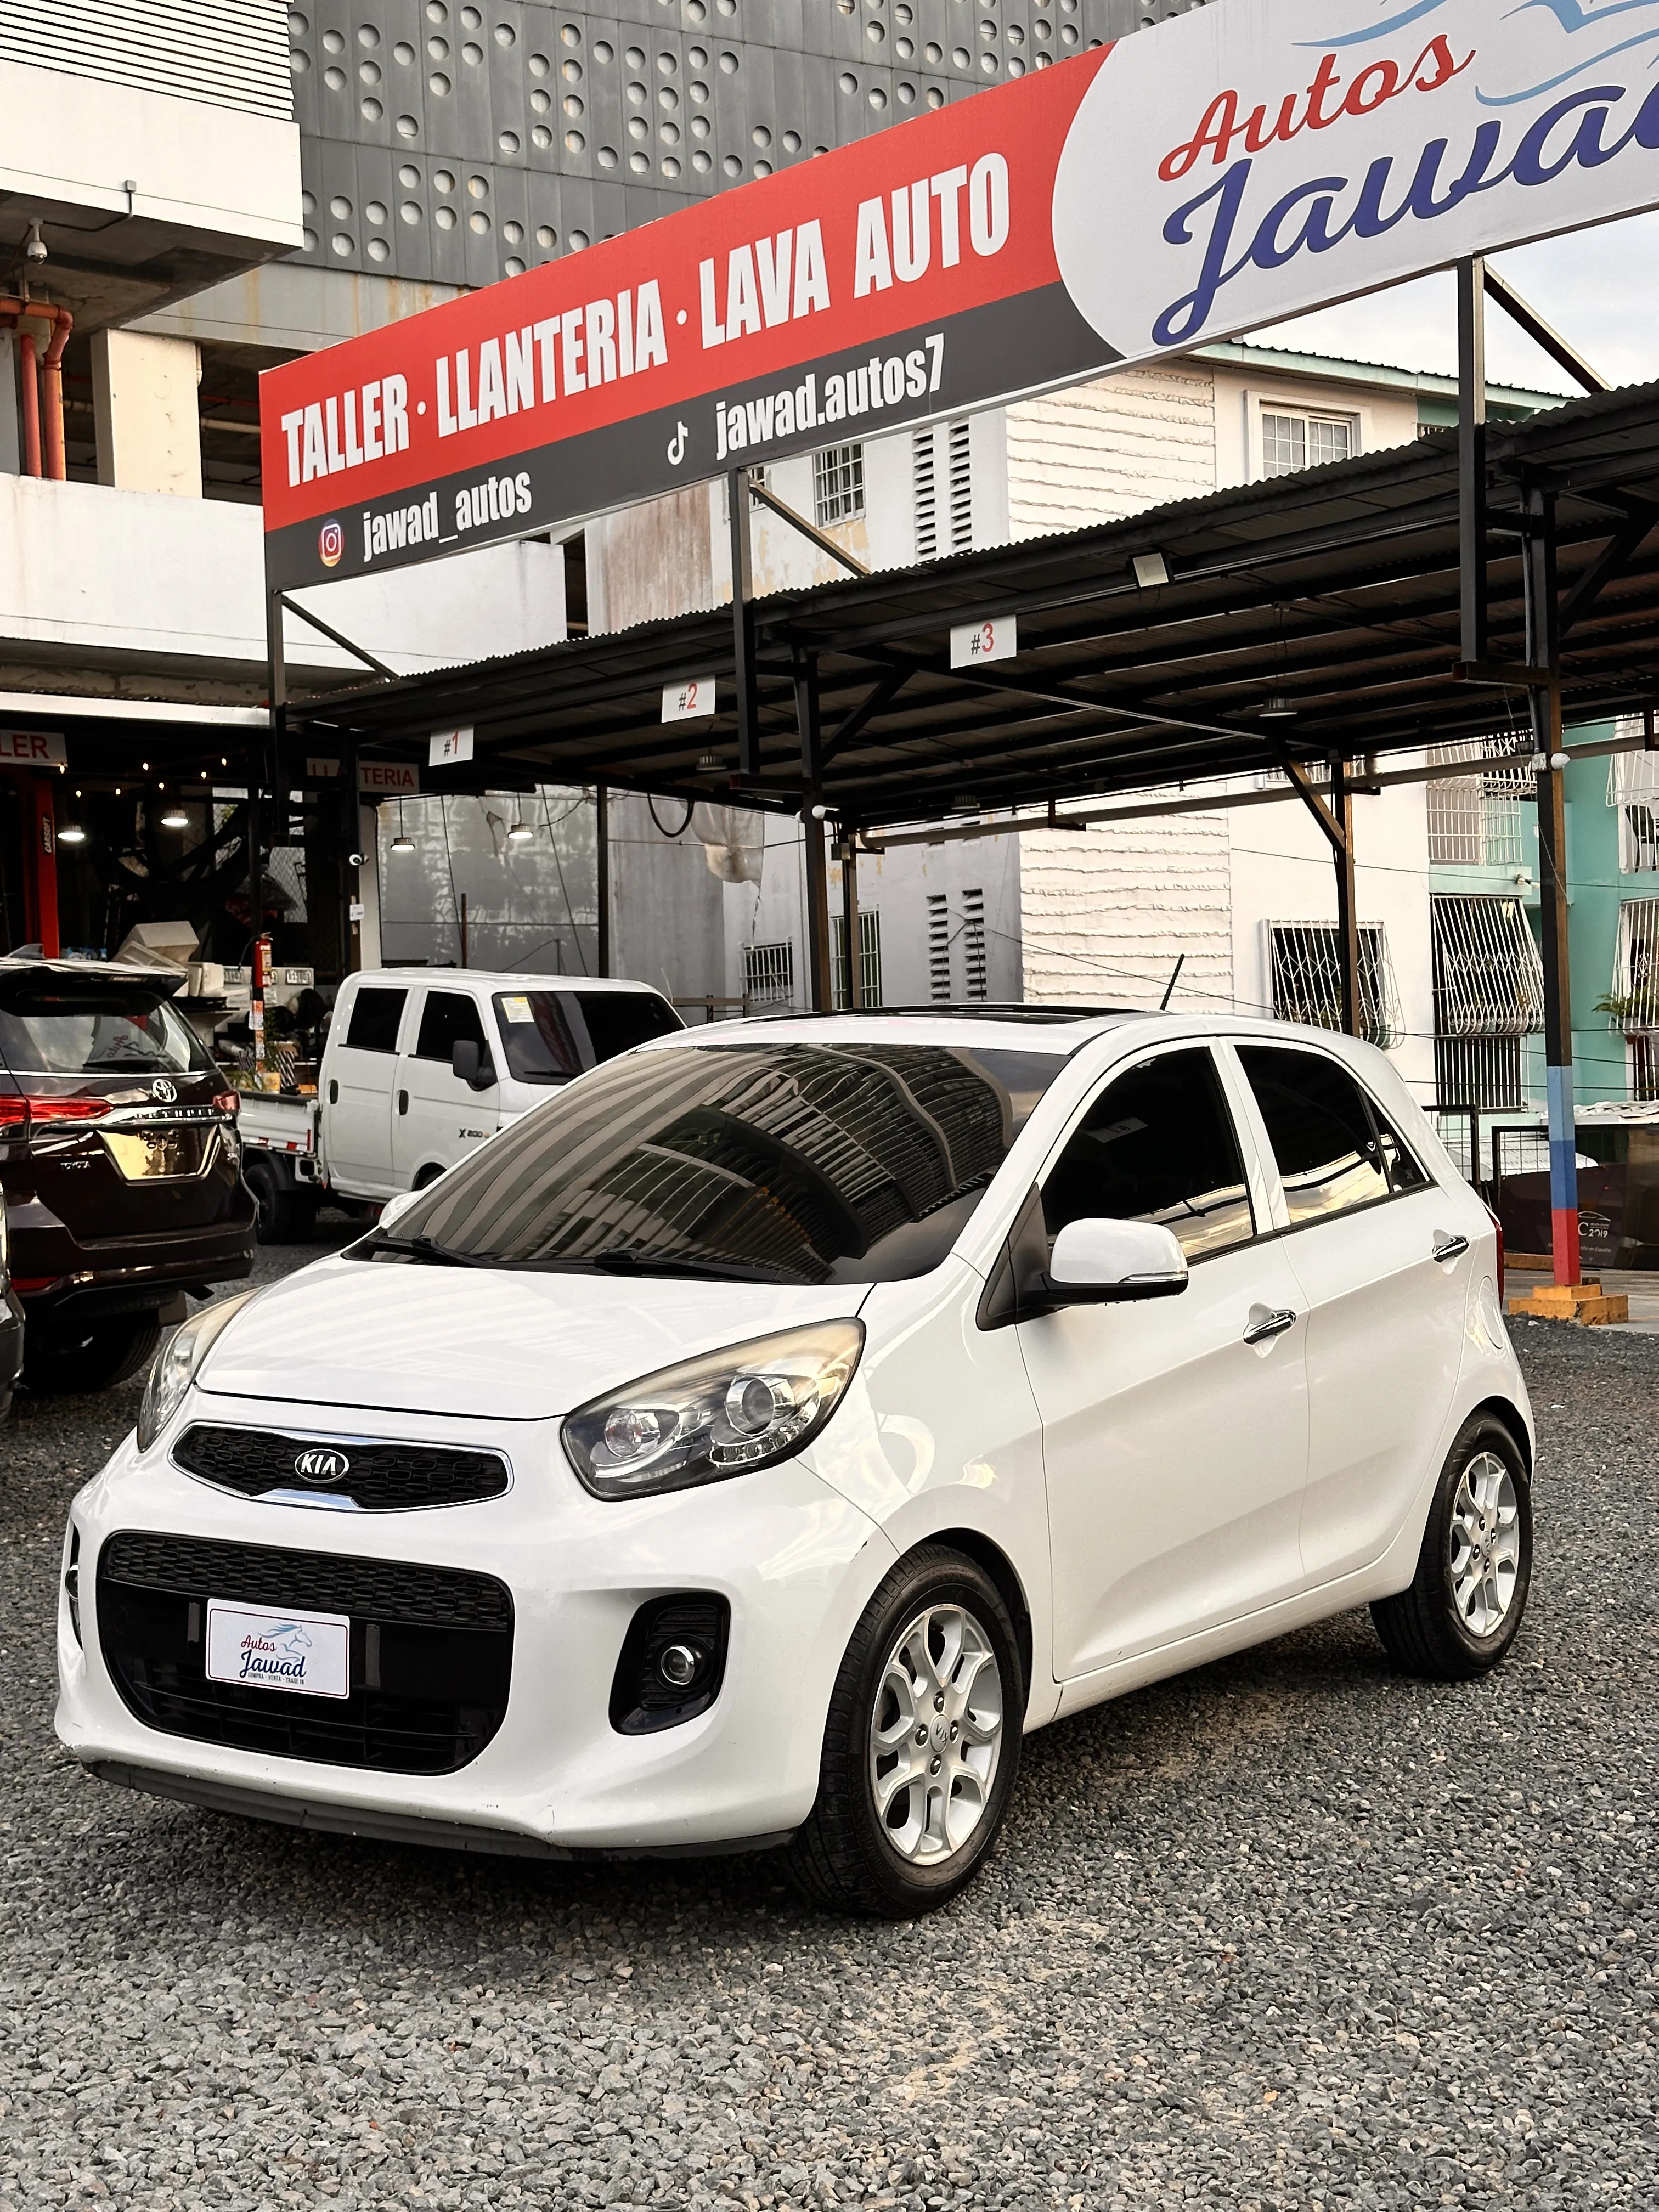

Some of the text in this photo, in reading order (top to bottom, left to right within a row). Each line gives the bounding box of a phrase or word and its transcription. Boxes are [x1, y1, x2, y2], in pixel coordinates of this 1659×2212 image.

[1158, 34, 1476, 182] Autos
[281, 153, 1009, 488] TALLER LLANTERIA LAVA AUTO
[716, 332, 945, 461] jawad.autos7
[363, 472, 532, 562] jawad_autos
[970, 623, 994, 655] #3
[678, 682, 698, 711] #2
[443, 731, 459, 757] #1
[300, 1454, 336, 1476] KIA
[241, 1634, 276, 1652] Autos
[239, 1649, 307, 1678] Jawad
